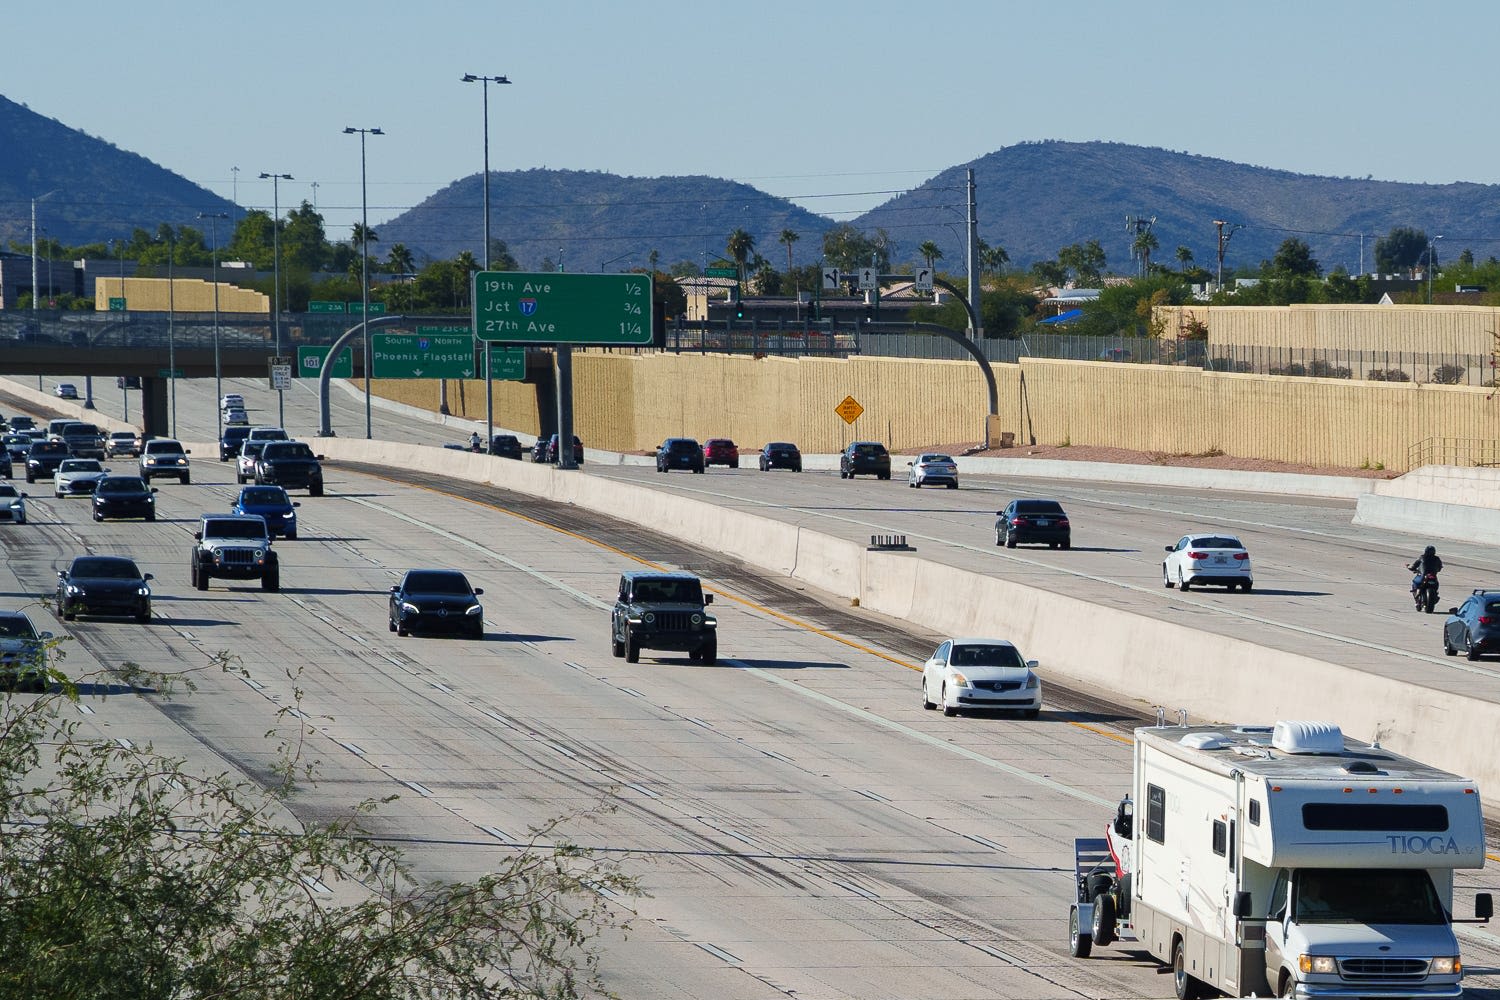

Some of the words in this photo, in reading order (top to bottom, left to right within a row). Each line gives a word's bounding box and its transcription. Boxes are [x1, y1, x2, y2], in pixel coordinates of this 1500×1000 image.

[484, 281, 514, 292] 19th
[523, 282, 551, 293] Ave
[484, 301, 510, 312] Jct
[522, 303, 534, 313] 17
[485, 320, 518, 331] 27th
[527, 321, 556, 332] Ave
[385, 337, 412, 345] SOUTH
[374, 352, 418, 361] Phoenix
[423, 353, 473, 362] Flagstaff
[1386, 836, 1460, 854] TIOGA
